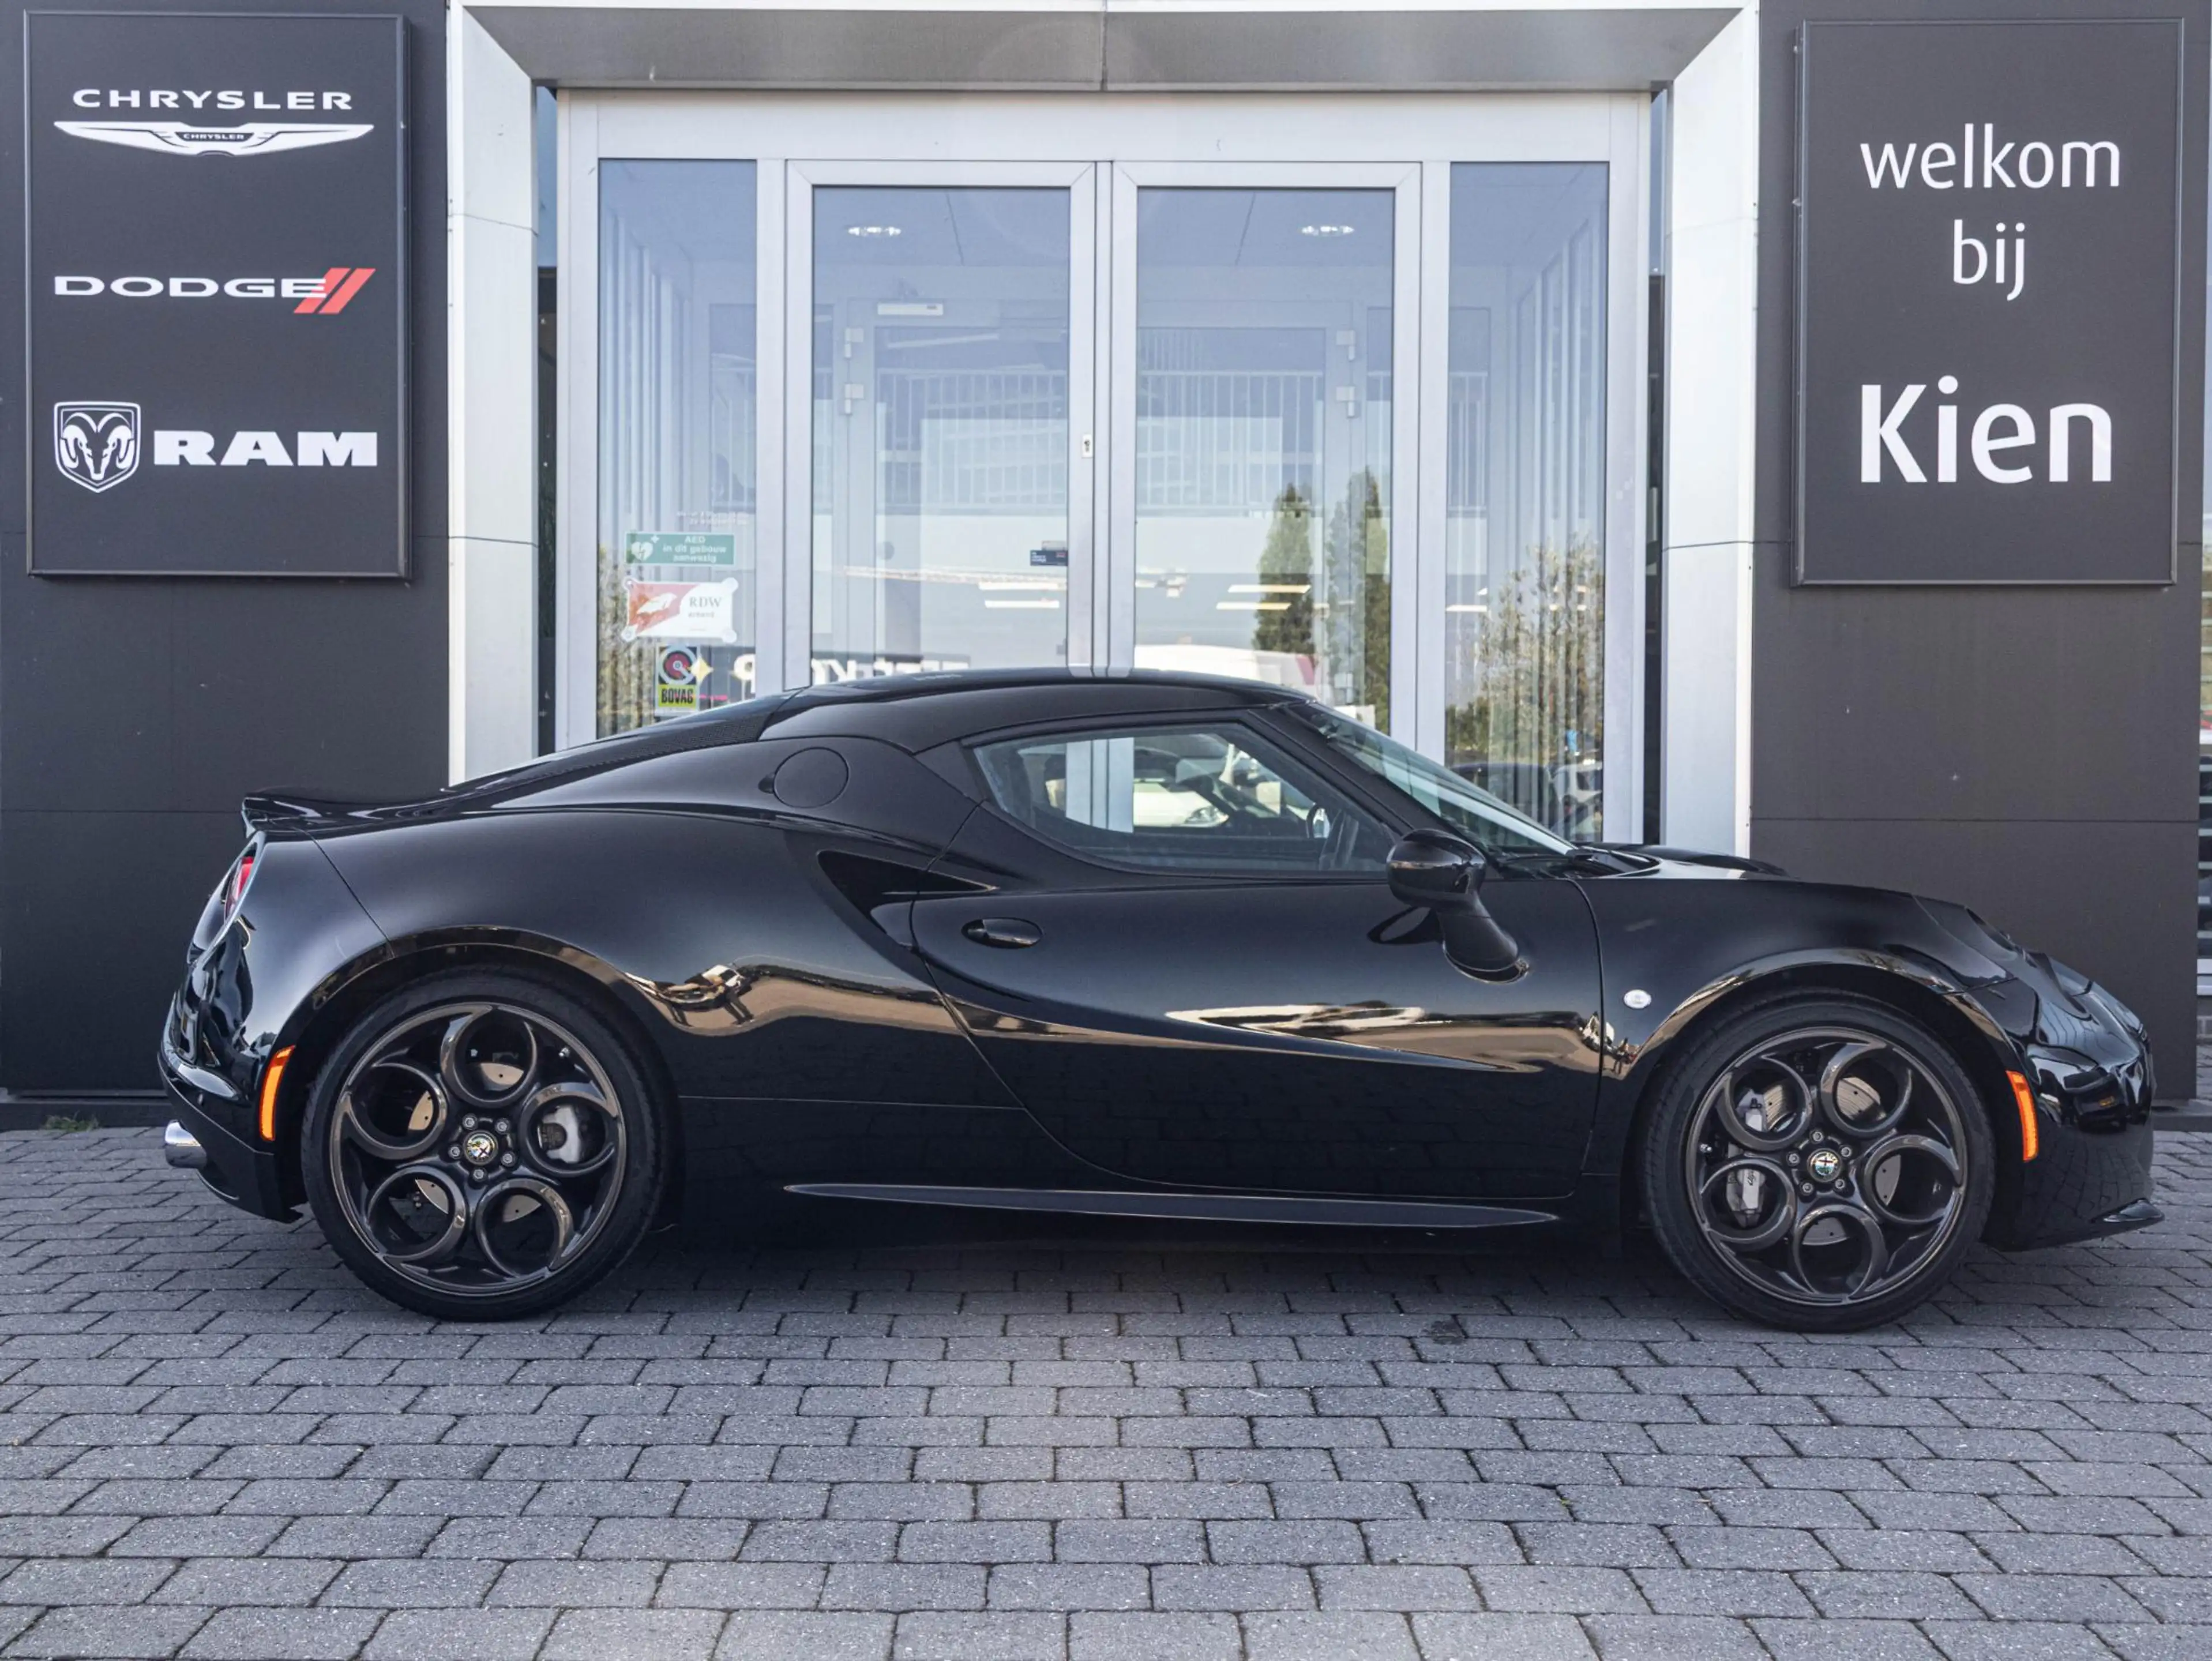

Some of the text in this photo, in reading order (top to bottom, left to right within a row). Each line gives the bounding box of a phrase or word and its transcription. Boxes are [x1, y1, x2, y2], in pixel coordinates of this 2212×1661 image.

[73, 89, 351, 109] CHRYSLER
[183, 133, 245, 141] CHRYSLER
[1860, 123, 2119, 189] welkom
[1954, 220, 2025, 300] bij
[55, 276, 327, 298] DODGE
[1861, 375, 2111, 483] Kien
[155, 431, 377, 466] RAM
[674, 544, 688, 553] dit
[690, 544, 727, 554] gebouw
[685, 536, 705, 544] AED
[689, 596, 722, 608] RDW
[660, 687, 694, 704] BOVAG
